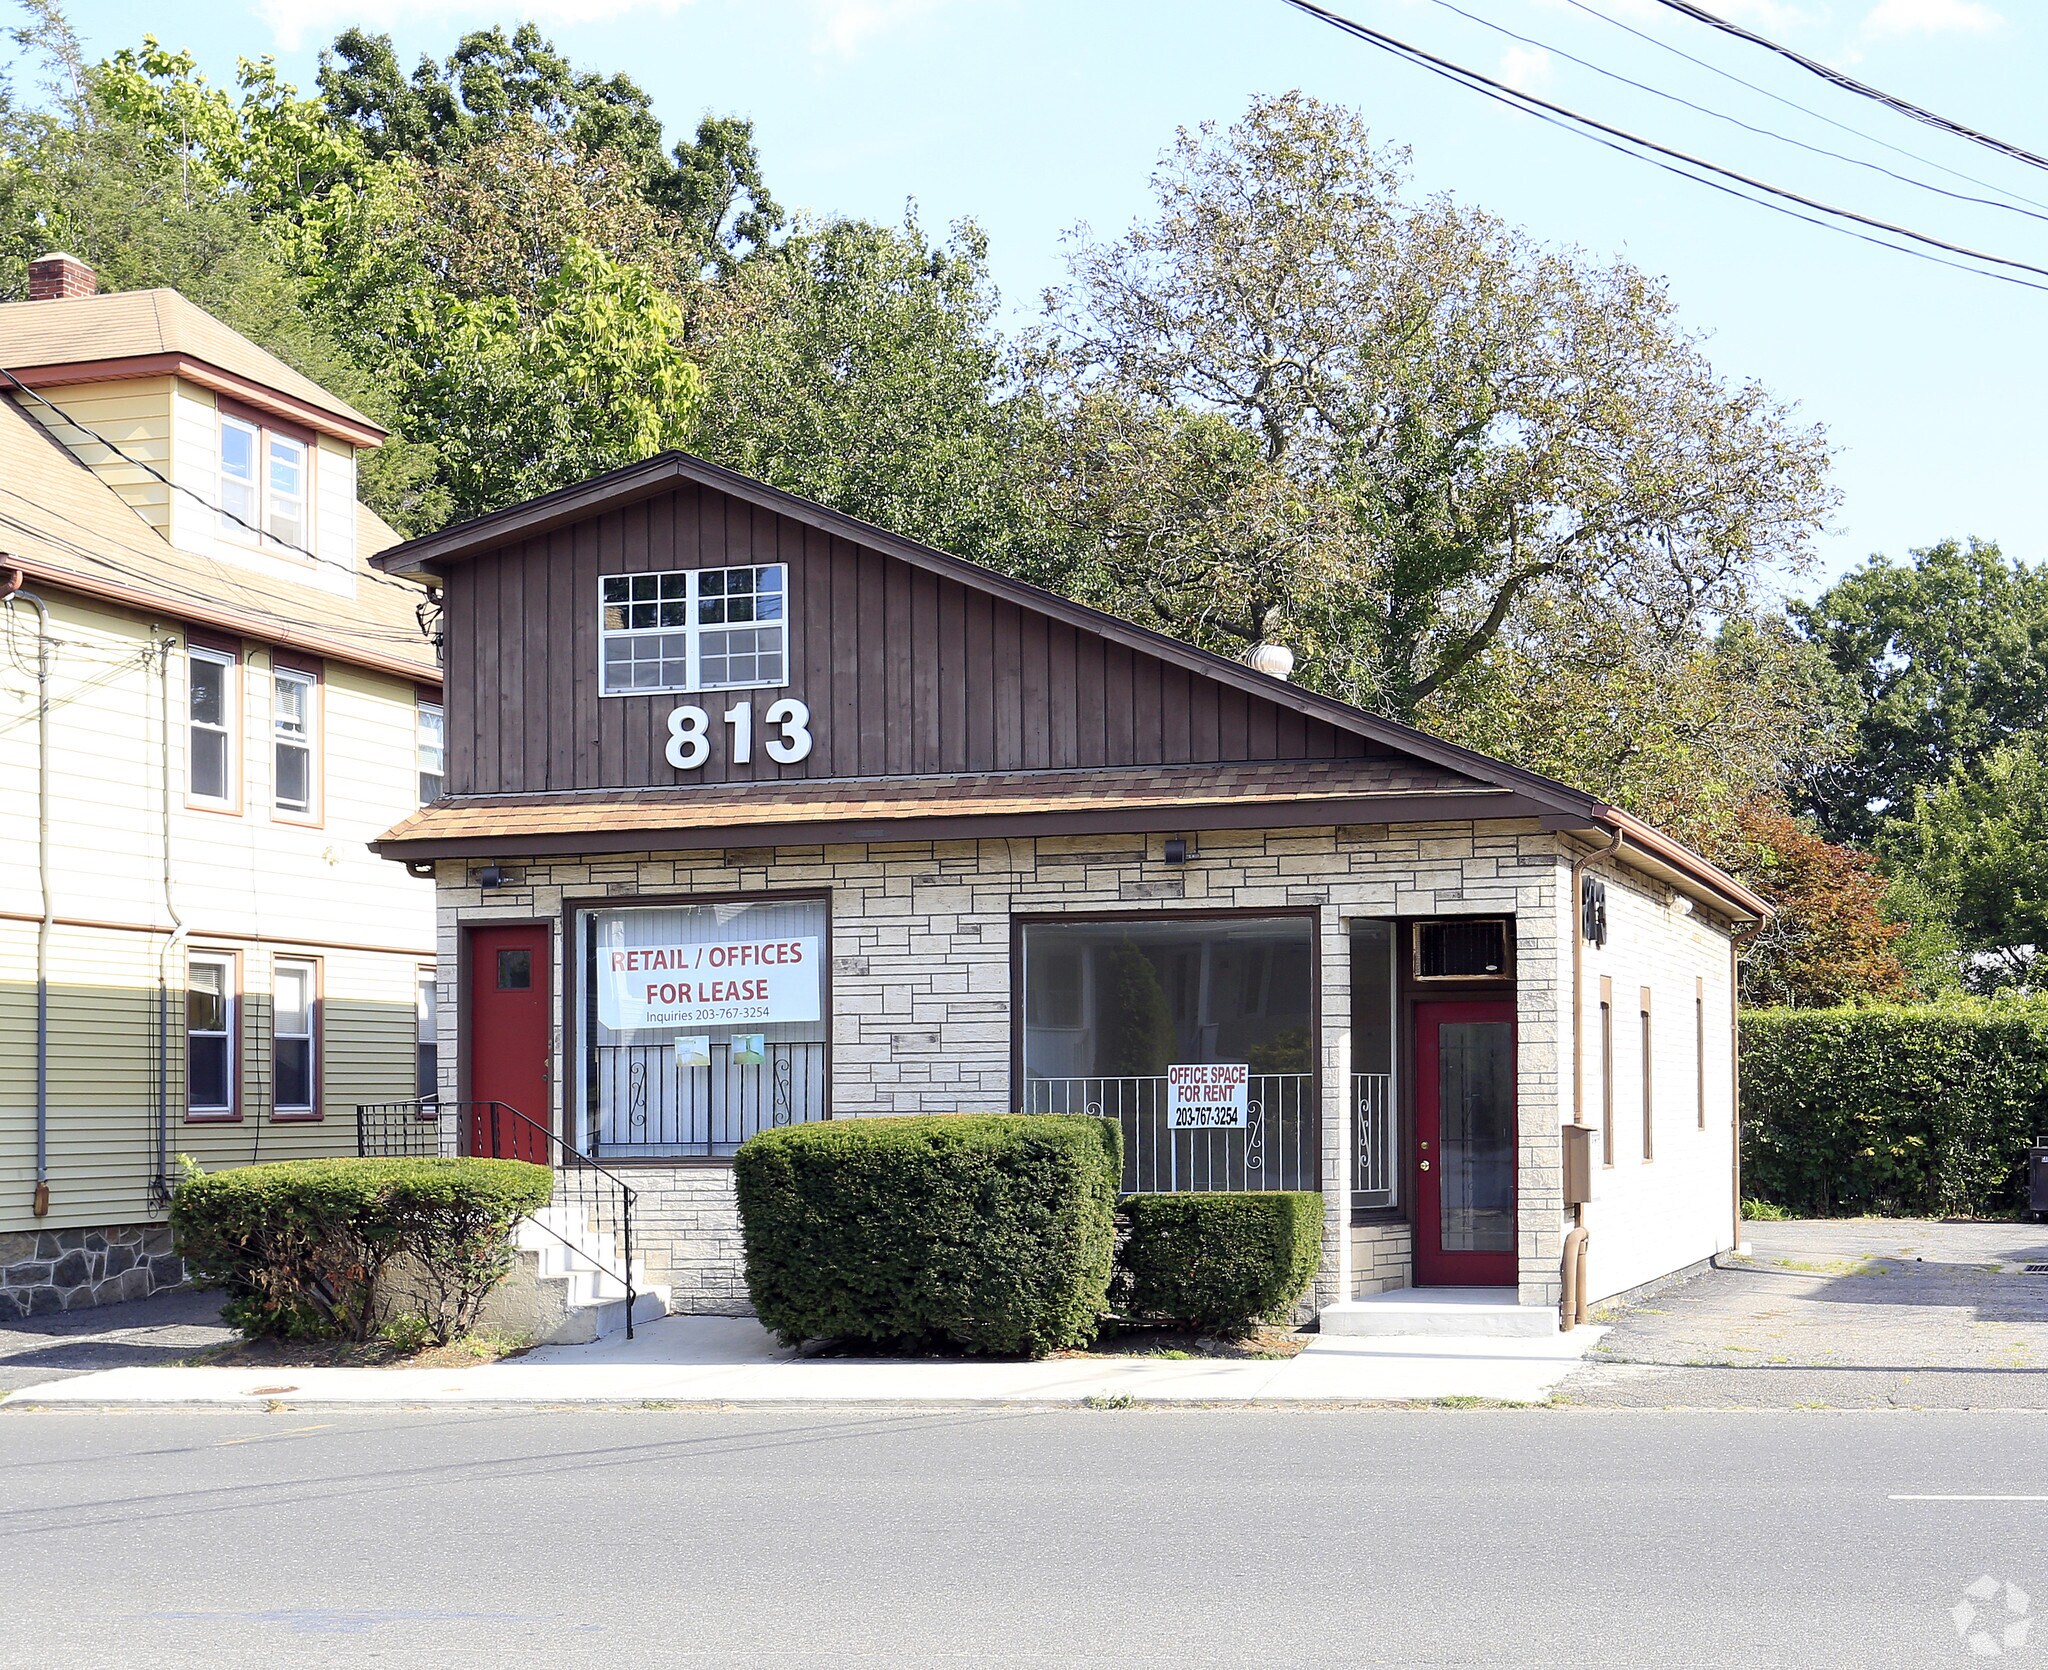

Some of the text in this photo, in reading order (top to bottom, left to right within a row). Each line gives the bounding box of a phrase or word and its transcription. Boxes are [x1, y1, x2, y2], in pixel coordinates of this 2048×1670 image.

[665, 698, 813, 770] 813
[611, 942, 803, 972] RETAIL / OFFICES
[646, 979, 769, 1004] FOR LEASE
[646, 1006, 770, 1024] Inquiries 203-767-3254
[1169, 1066, 1247, 1085] OFFICE SPACE
[1177, 1084, 1235, 1103] FOR RENT
[1175, 1106, 1239, 1126] 203-767-3254
